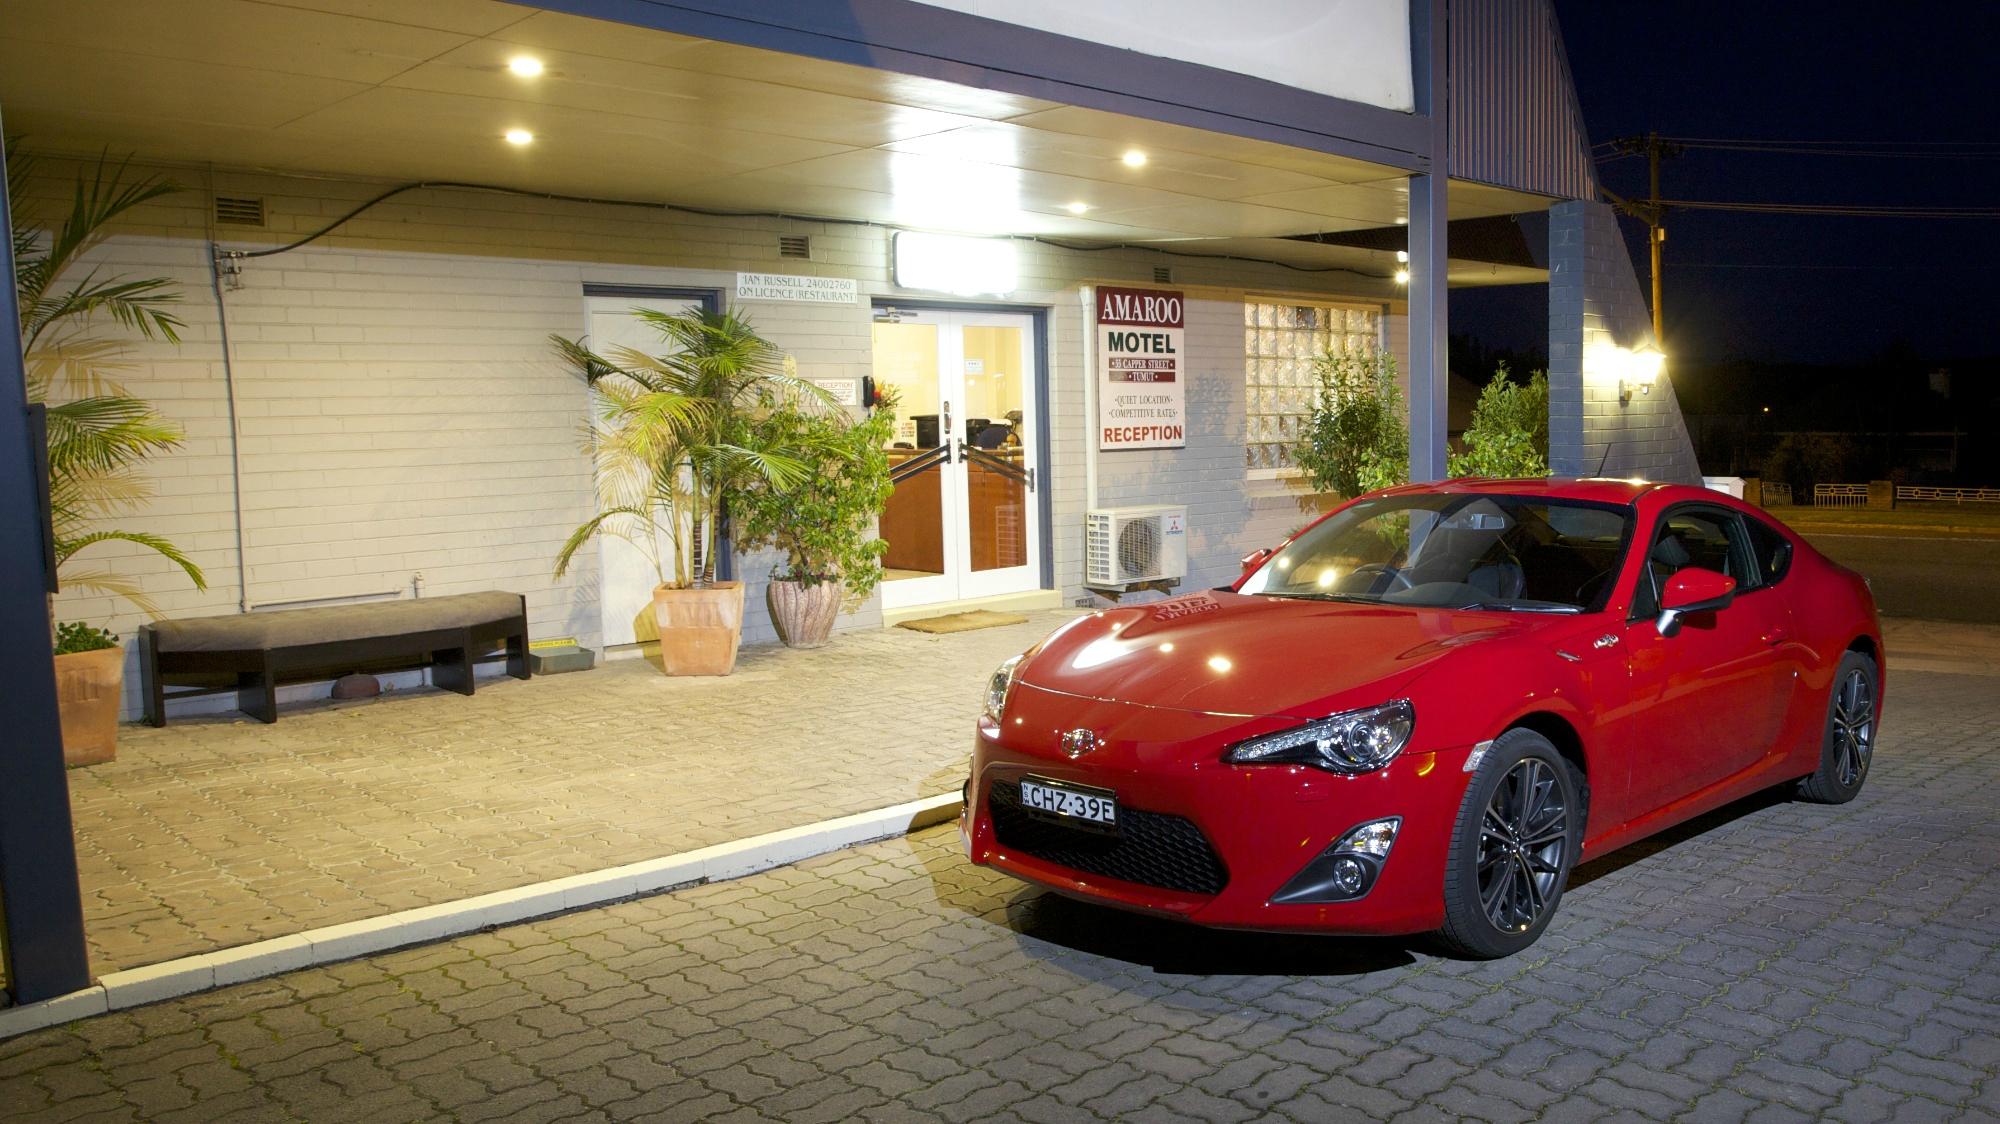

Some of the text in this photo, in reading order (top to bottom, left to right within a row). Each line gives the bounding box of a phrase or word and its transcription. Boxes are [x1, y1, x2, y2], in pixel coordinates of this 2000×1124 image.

[763, 275, 803, 288] RUSSELL
[807, 279, 851, 290] 24002760
[755, 286, 794, 299] LICENCE
[1101, 293, 1181, 324] AMAROO
[1108, 331, 1176, 354] MOTEL
[1122, 358, 1147, 369] CAPPER
[1148, 360, 1169, 370] STREET
[1132, 371, 1154, 382] TUMUT
[1157, 408, 1176, 418] RATES
[1104, 425, 1182, 443] RECEPTION
